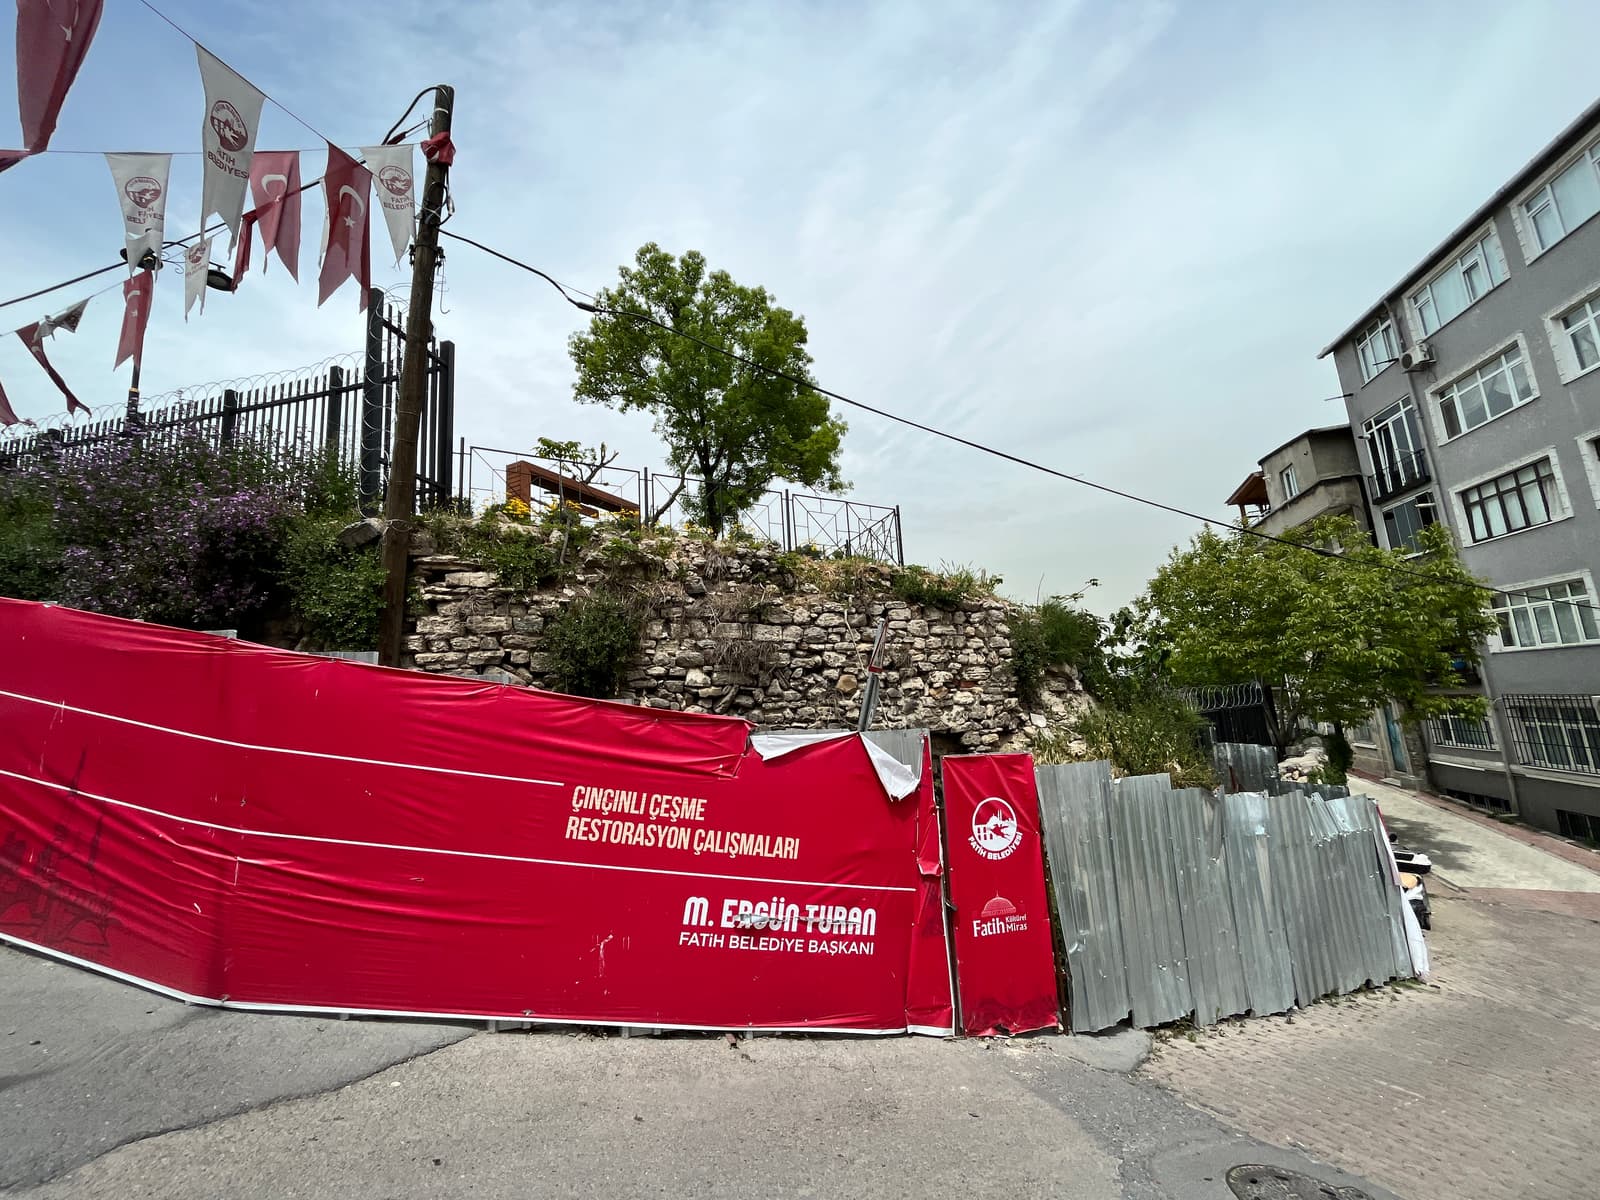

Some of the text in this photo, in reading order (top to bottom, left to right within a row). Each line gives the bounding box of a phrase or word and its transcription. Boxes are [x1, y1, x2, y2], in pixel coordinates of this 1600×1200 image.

[649, 793, 708, 822] ÇEŞME
[565, 816, 800, 860] RESTORASYON ÇALIŞMALARI
[683, 896, 714, 927] M.
[804, 904, 876, 936] TURAN
[973, 917, 1005, 937] Fatih
[1006, 922, 1028, 933] Miras
[678, 931, 874, 956] FATİH BELEDİYE BAŞKANI
